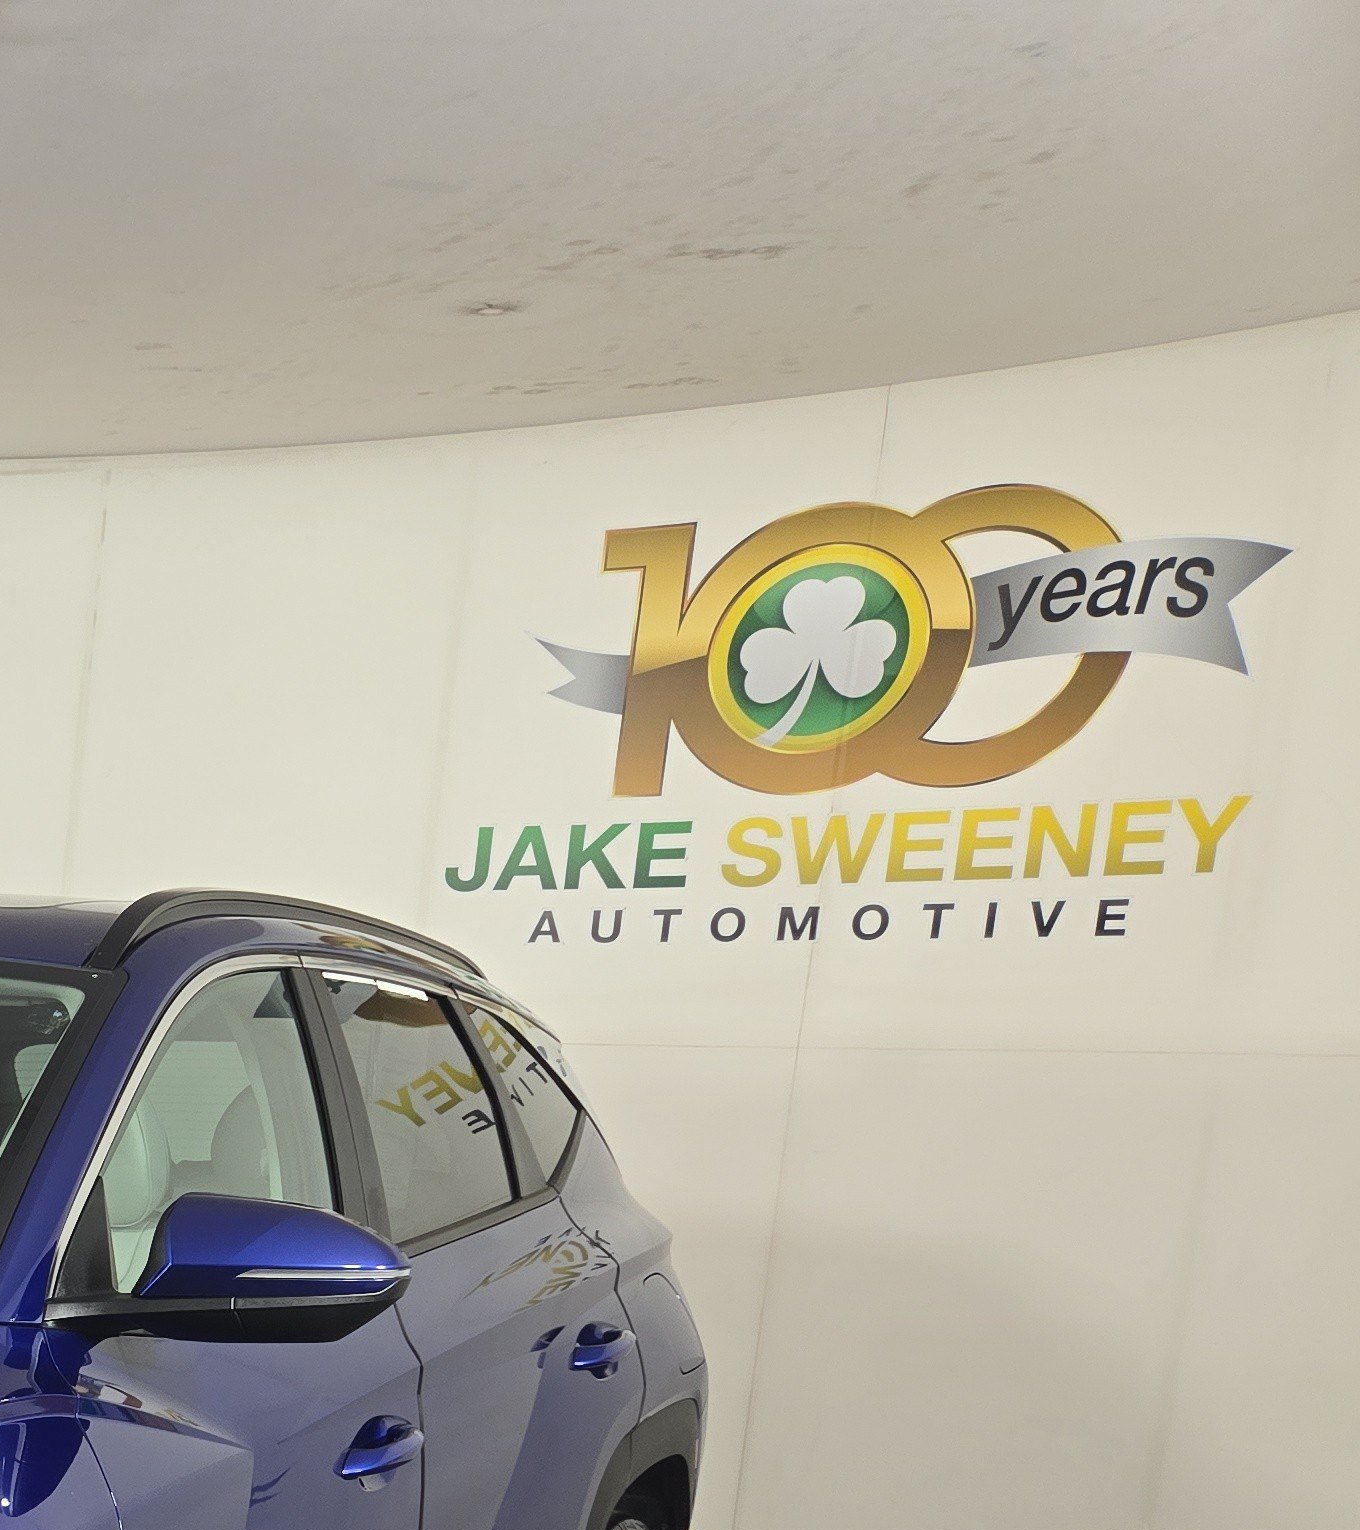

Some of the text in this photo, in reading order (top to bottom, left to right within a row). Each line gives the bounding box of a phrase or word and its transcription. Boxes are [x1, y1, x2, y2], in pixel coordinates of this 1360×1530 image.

[986, 556, 1215, 652] years
[444, 794, 1254, 892] JAKE SWEENEY
[528, 898, 1133, 945] AUTOMOTIVE
